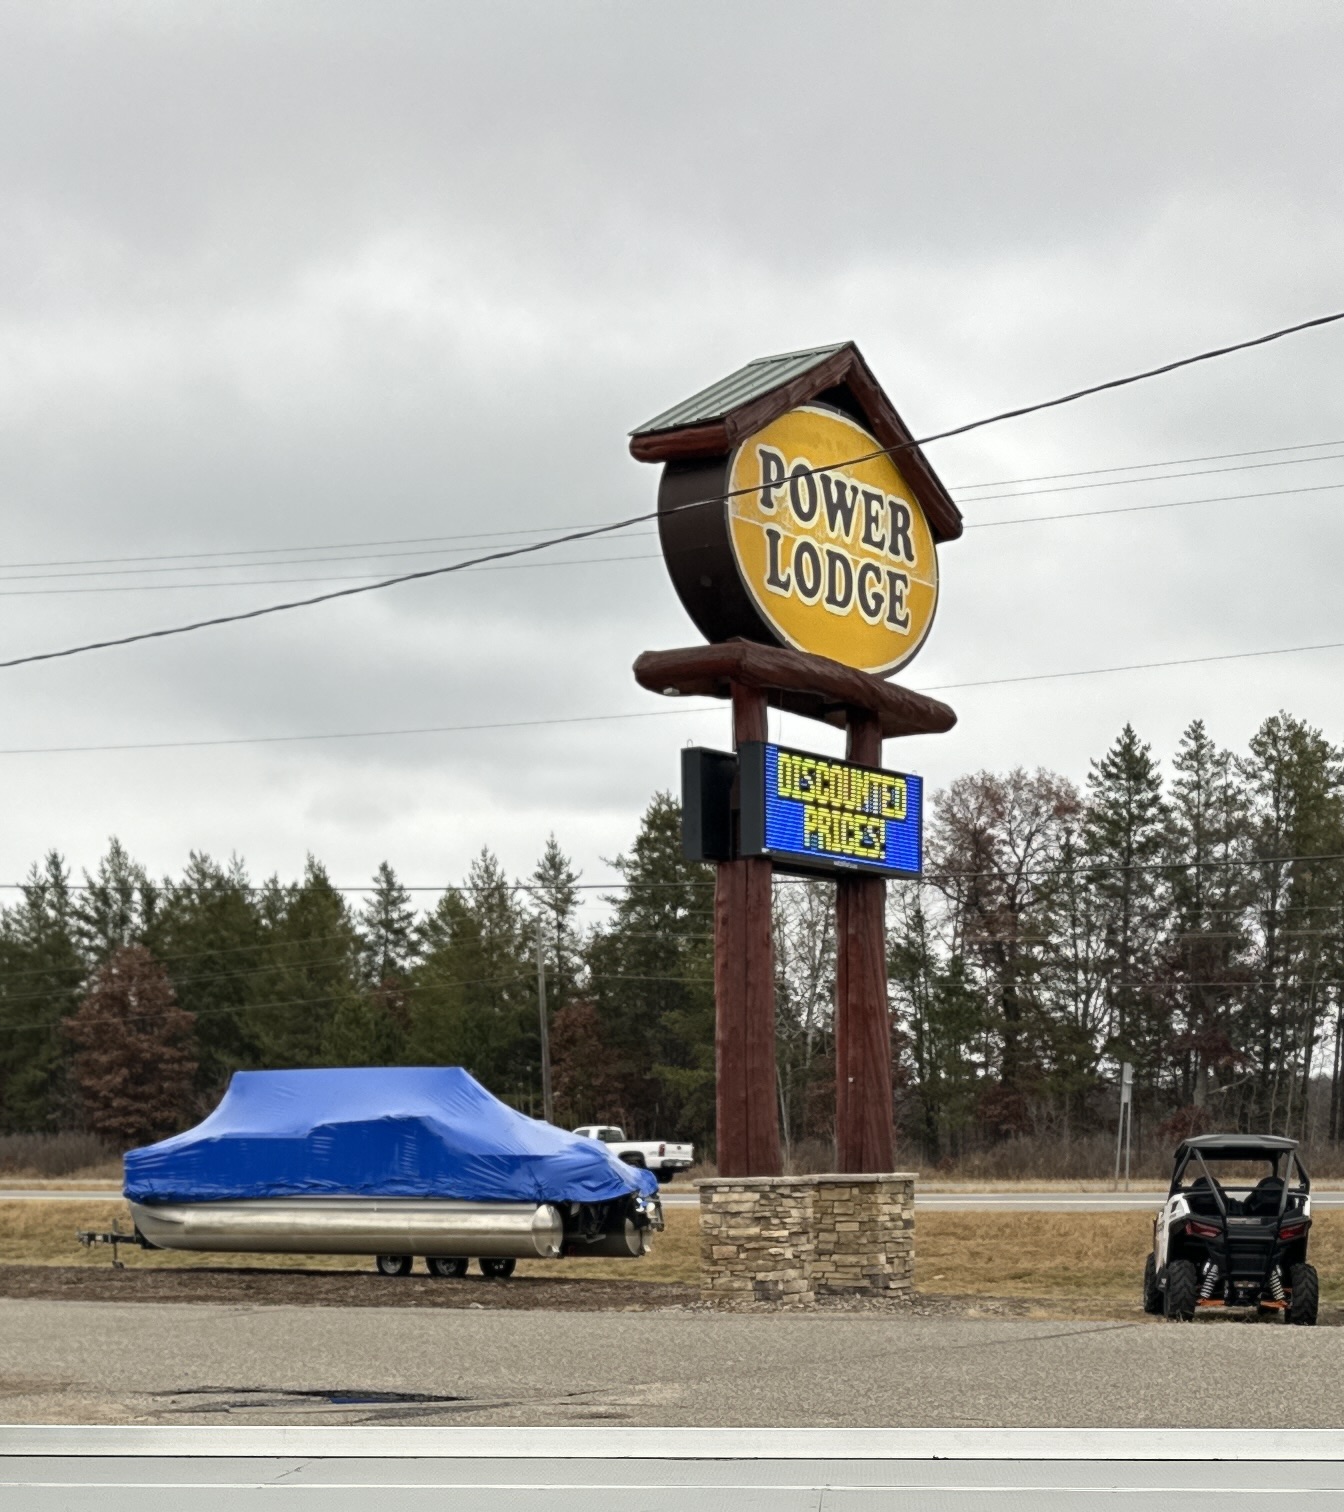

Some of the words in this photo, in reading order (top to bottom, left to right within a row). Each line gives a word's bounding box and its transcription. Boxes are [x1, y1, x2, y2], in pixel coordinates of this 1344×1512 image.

[758, 447, 915, 564] POWER
[766, 526, 910, 631] LODGE
[778, 752, 907, 820] DISCOUNTED
[804, 804, 886, 860] PRICES!
